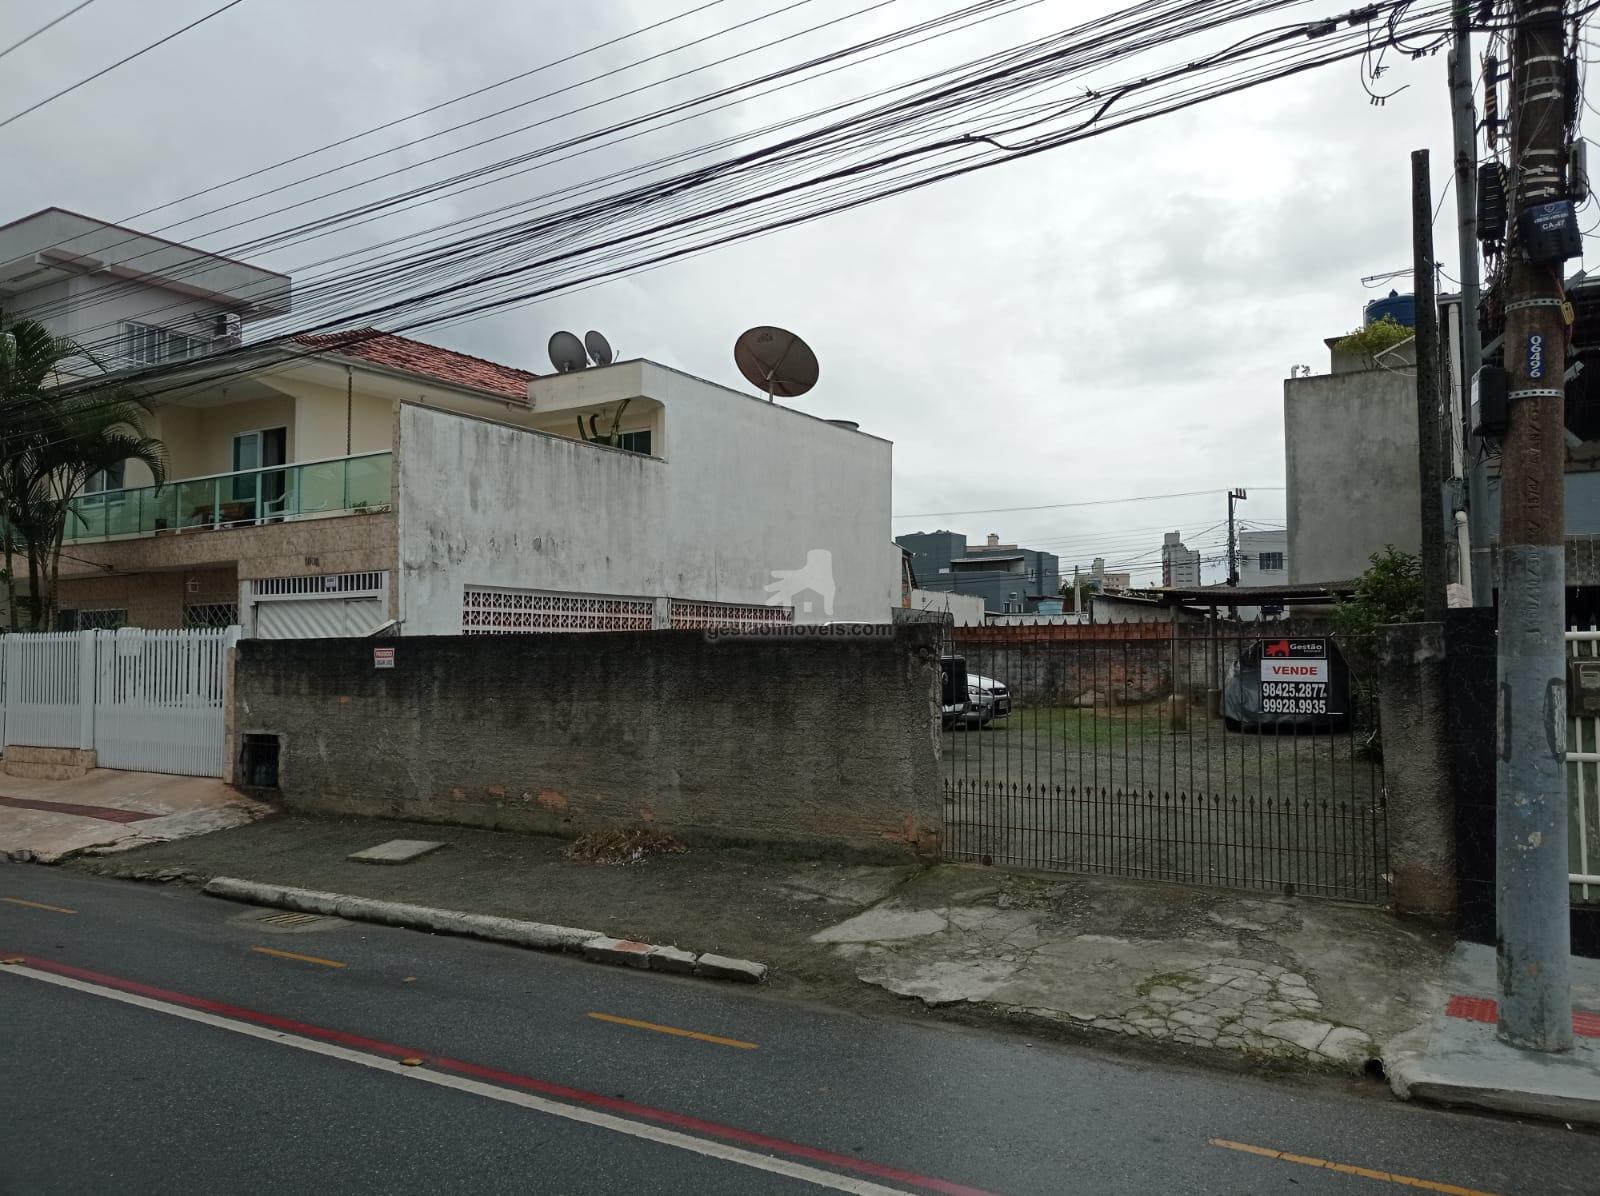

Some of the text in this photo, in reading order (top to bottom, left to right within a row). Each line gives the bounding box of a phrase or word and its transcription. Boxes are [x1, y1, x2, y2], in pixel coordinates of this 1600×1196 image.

[1530, 335, 1542, 378] 06496
[1272, 666, 1318, 676] VENDE
[1263, 682, 1326, 698] 98425.2877
[1263, 699, 1326, 714] 99928.9935
